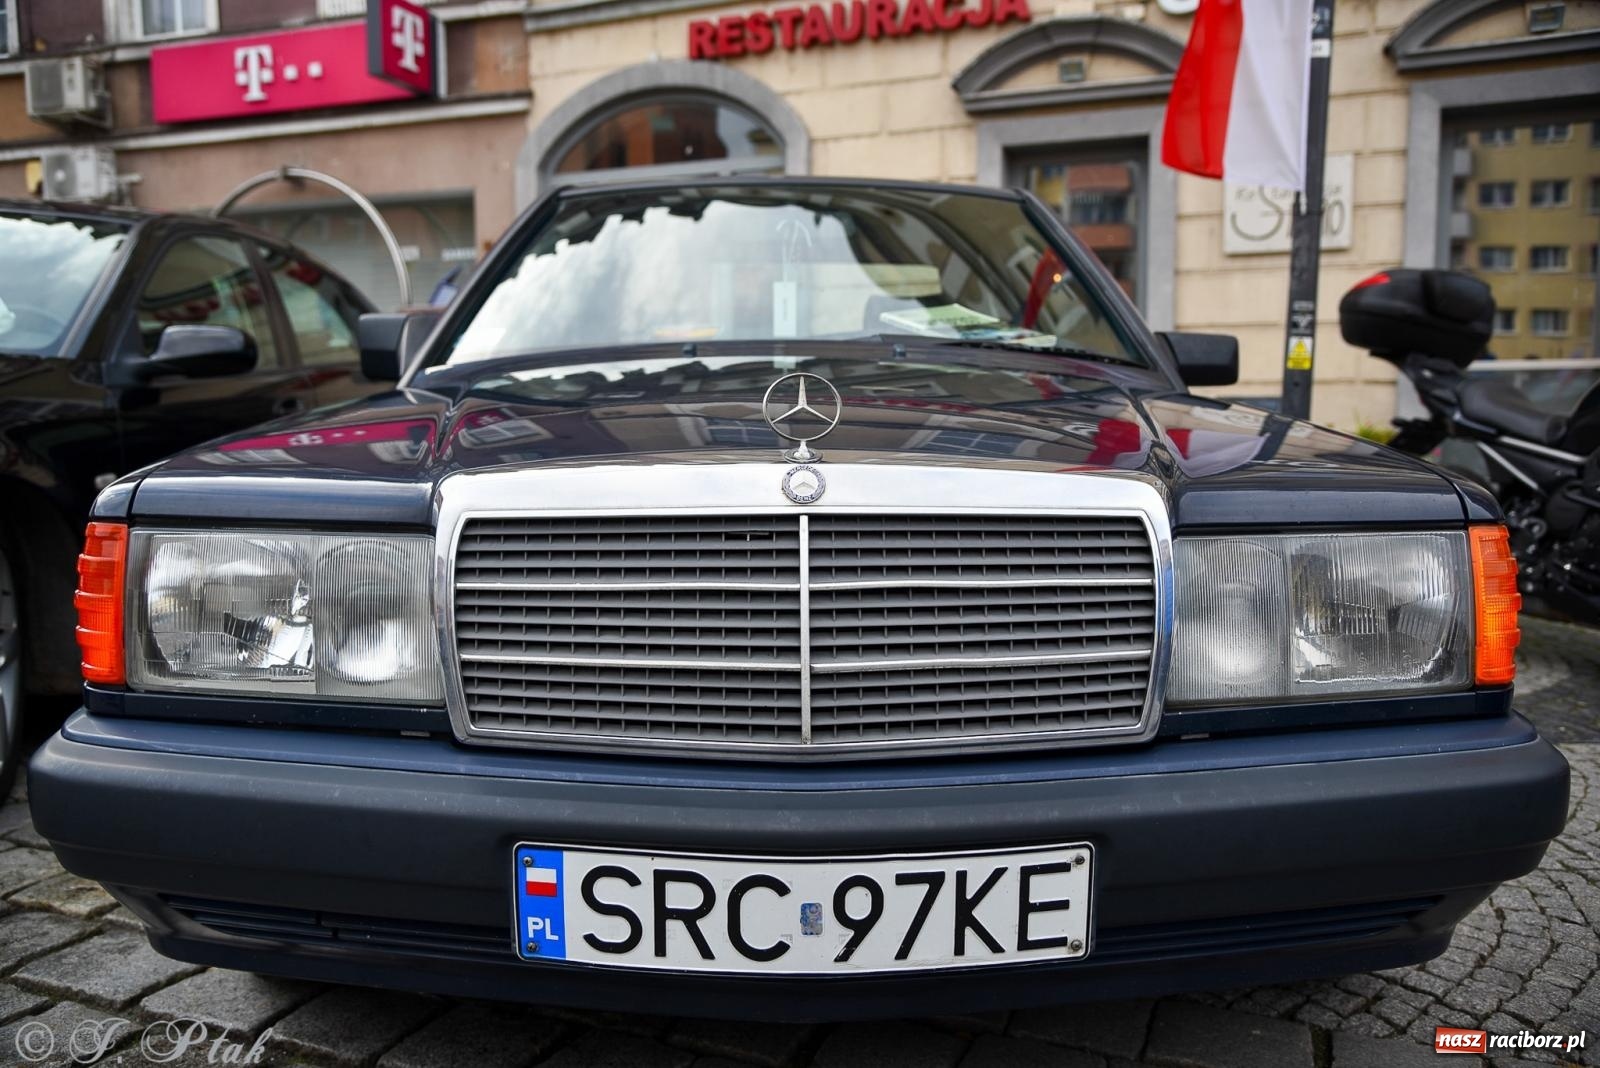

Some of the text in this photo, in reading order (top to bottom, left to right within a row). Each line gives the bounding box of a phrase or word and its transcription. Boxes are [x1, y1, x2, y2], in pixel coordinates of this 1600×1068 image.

[688, 0, 1032, 59] RESTAURACJA
[527, 916, 560, 941] PL
[580, 862, 1072, 963] SRC 97KE
